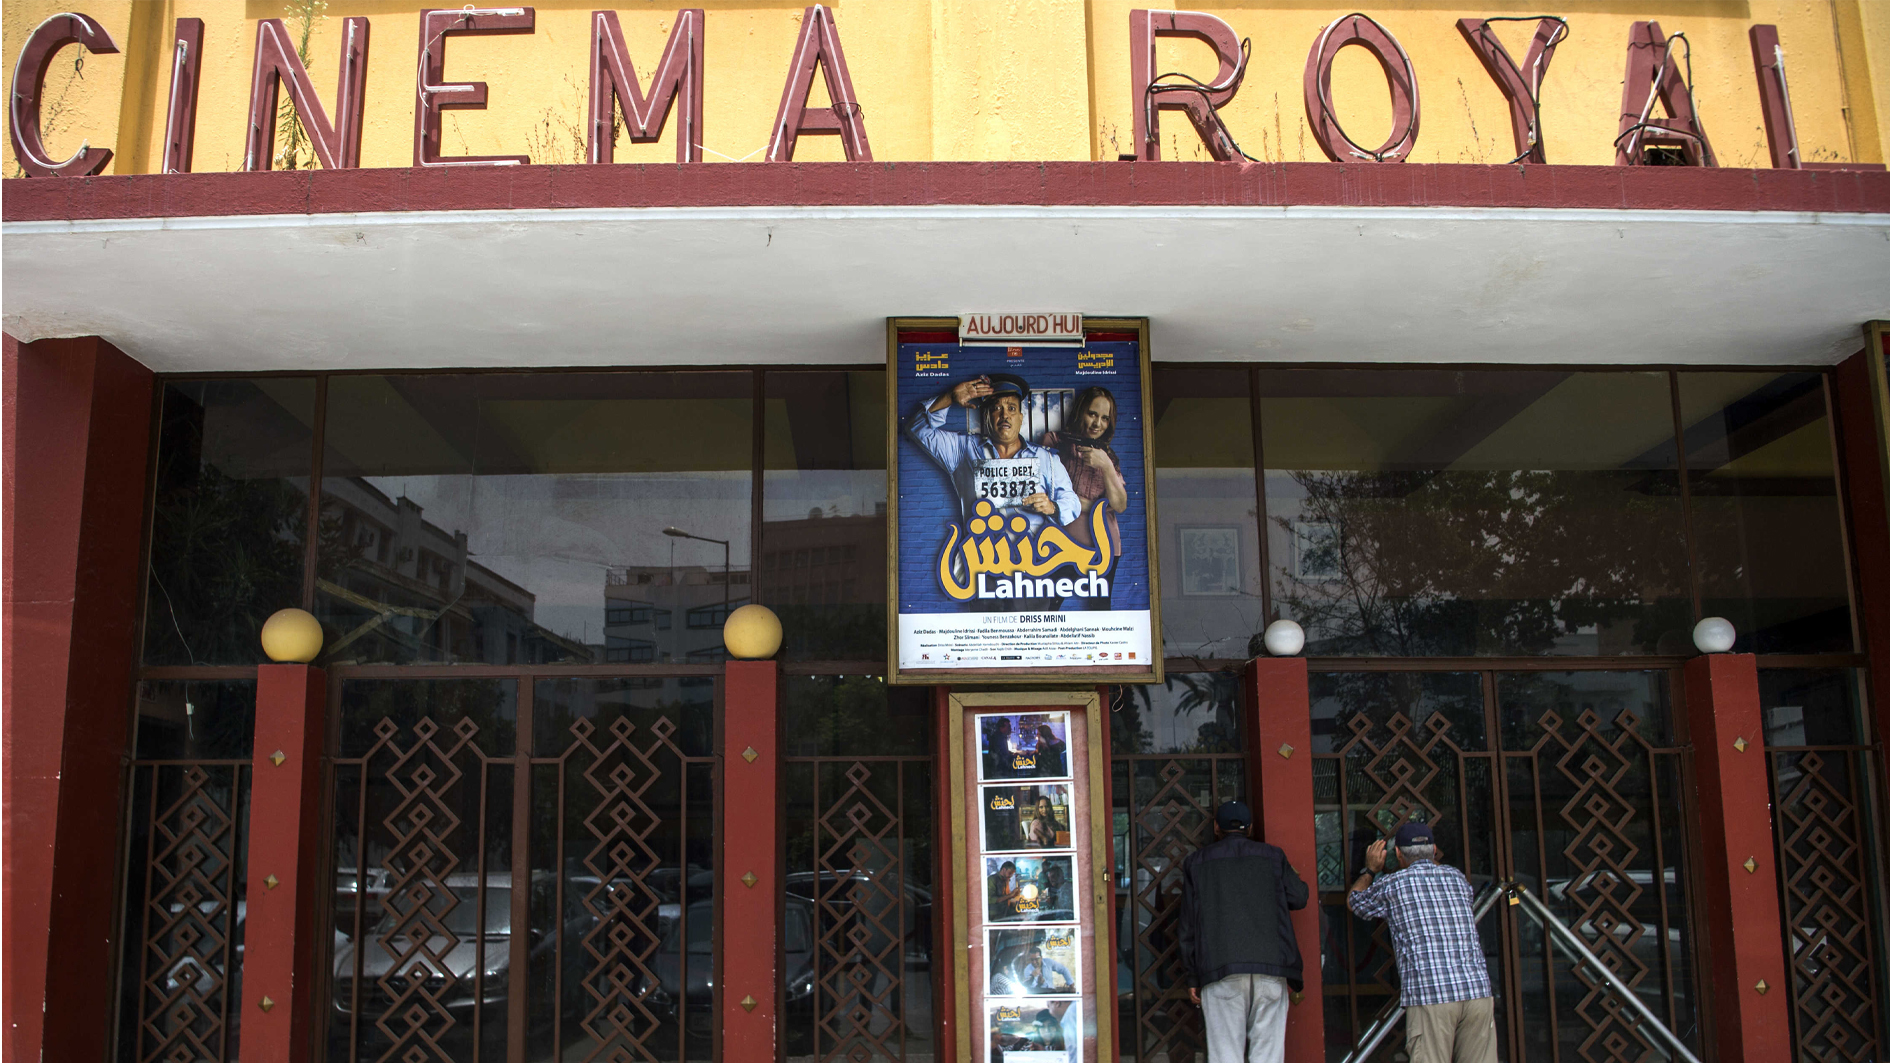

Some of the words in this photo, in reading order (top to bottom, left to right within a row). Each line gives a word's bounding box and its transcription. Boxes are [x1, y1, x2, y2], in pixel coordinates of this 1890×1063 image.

[10, 4, 873, 177] CINEMA
[967, 314, 1080, 335] AUJOURD'HUI
[915, 351, 949, 362] عزيز
[1077, 350, 1114, 361] مجدولين
[915, 360, 949, 371] دادس
[980, 466, 1008, 478] POLICE
[1012, 465, 1035, 477] DEPT.
[981, 480, 1037, 498] 563873
[939, 499, 1111, 601] لحنش
[977, 571, 1109, 599] Lahnech
[982, 616, 992, 624] UN
[993, 615, 1008, 624] FILM
[1009, 615, 1018, 623] DE
[1020, 614, 1042, 623] DRISS
[1043, 614, 1066, 623] MRINI
